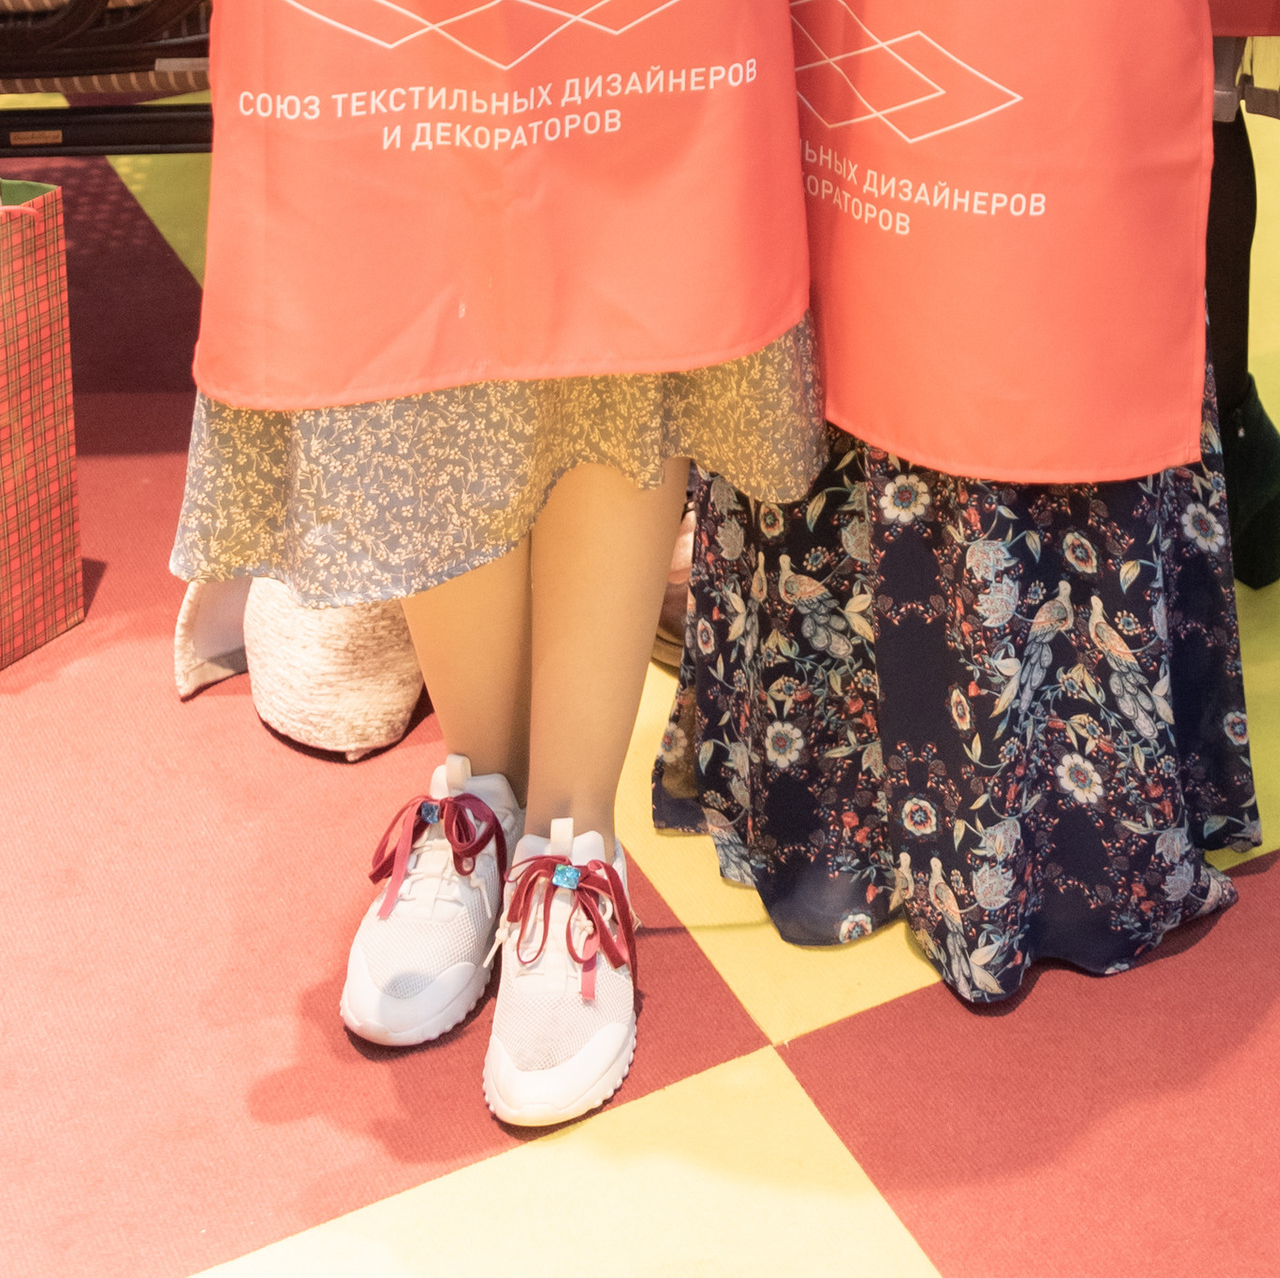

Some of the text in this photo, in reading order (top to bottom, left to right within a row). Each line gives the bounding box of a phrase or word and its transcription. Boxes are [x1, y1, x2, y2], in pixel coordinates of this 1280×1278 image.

[239, 57, 758, 121] СОЮЗ ТЕКСТИЛЬНЫХ ДИЗАЙНЕРОВ
[382, 108, 623, 152] И ДЕКОРАТОРОВ
[800, 139, 1046, 216] ЬНЫХ ДИЗАЙНЕРОВ
